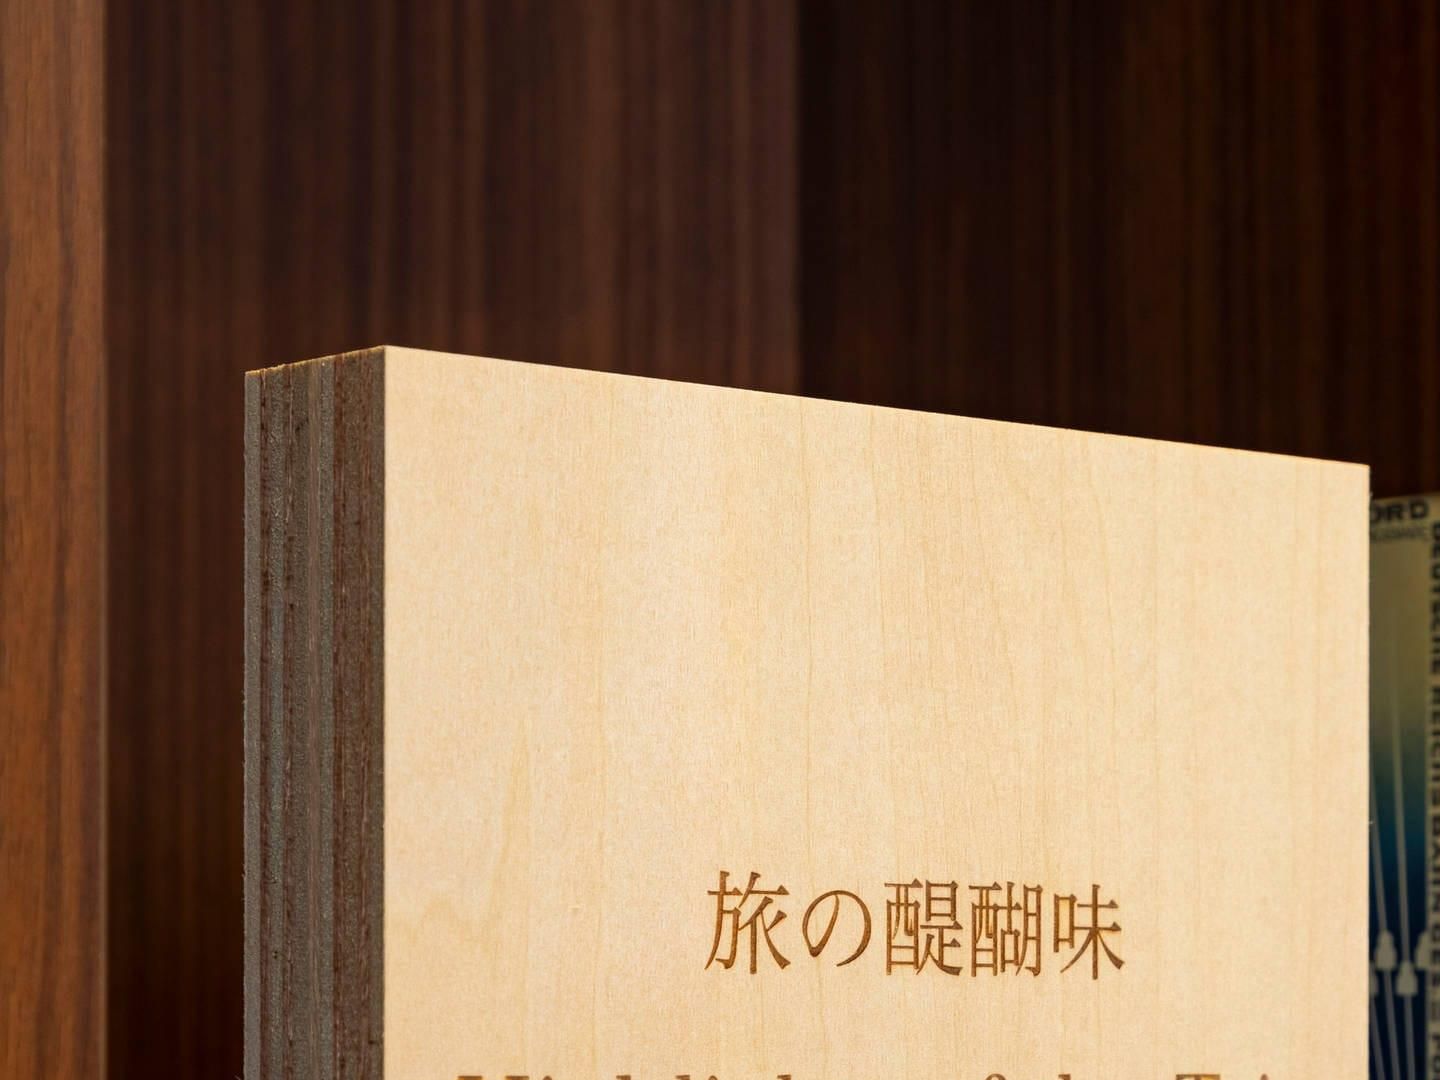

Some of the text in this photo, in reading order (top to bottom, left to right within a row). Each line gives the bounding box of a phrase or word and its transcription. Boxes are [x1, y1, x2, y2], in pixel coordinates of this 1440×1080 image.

[703, 869, 1128, 981] 旅の醍醐味
